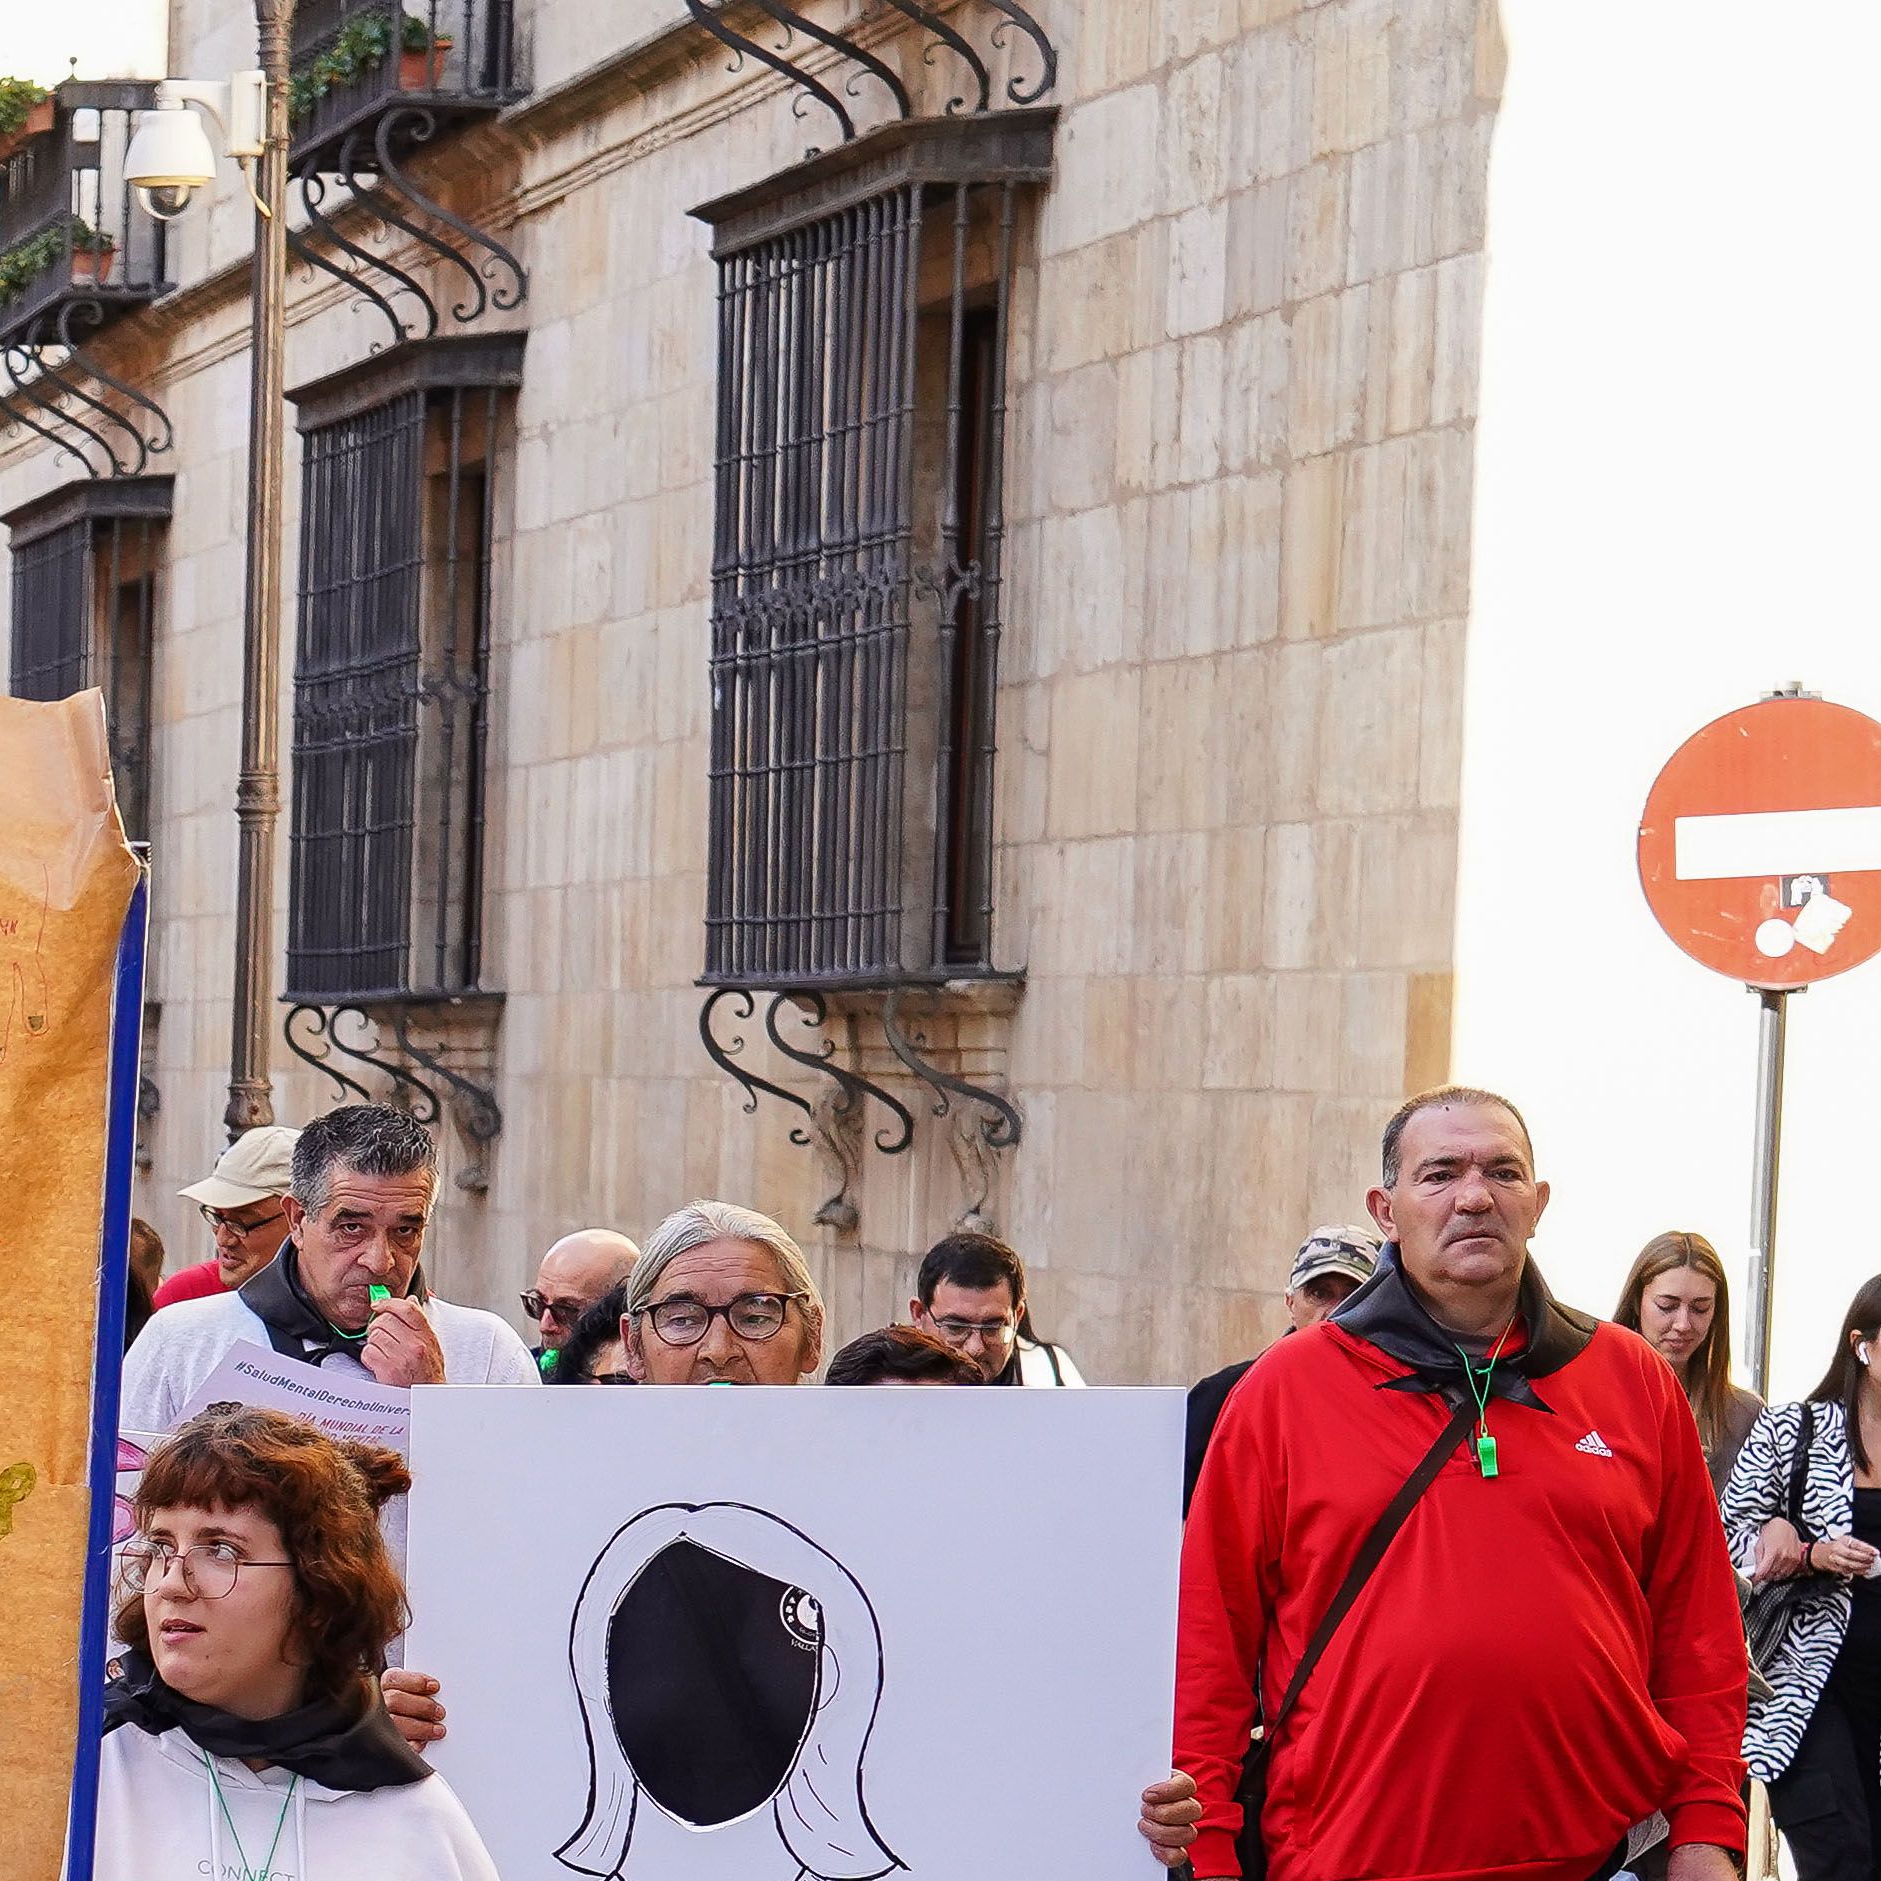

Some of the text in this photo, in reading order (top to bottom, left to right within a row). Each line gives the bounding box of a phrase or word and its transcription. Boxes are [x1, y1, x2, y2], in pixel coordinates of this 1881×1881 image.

[320, 1417, 370, 1434] MUNDIAL
[371, 1424, 390, 1435] DE
[391, 1426, 405, 1436] LA
[1575, 1443, 1612, 1458] adidas
[790, 1638, 818, 1652] VALLA
